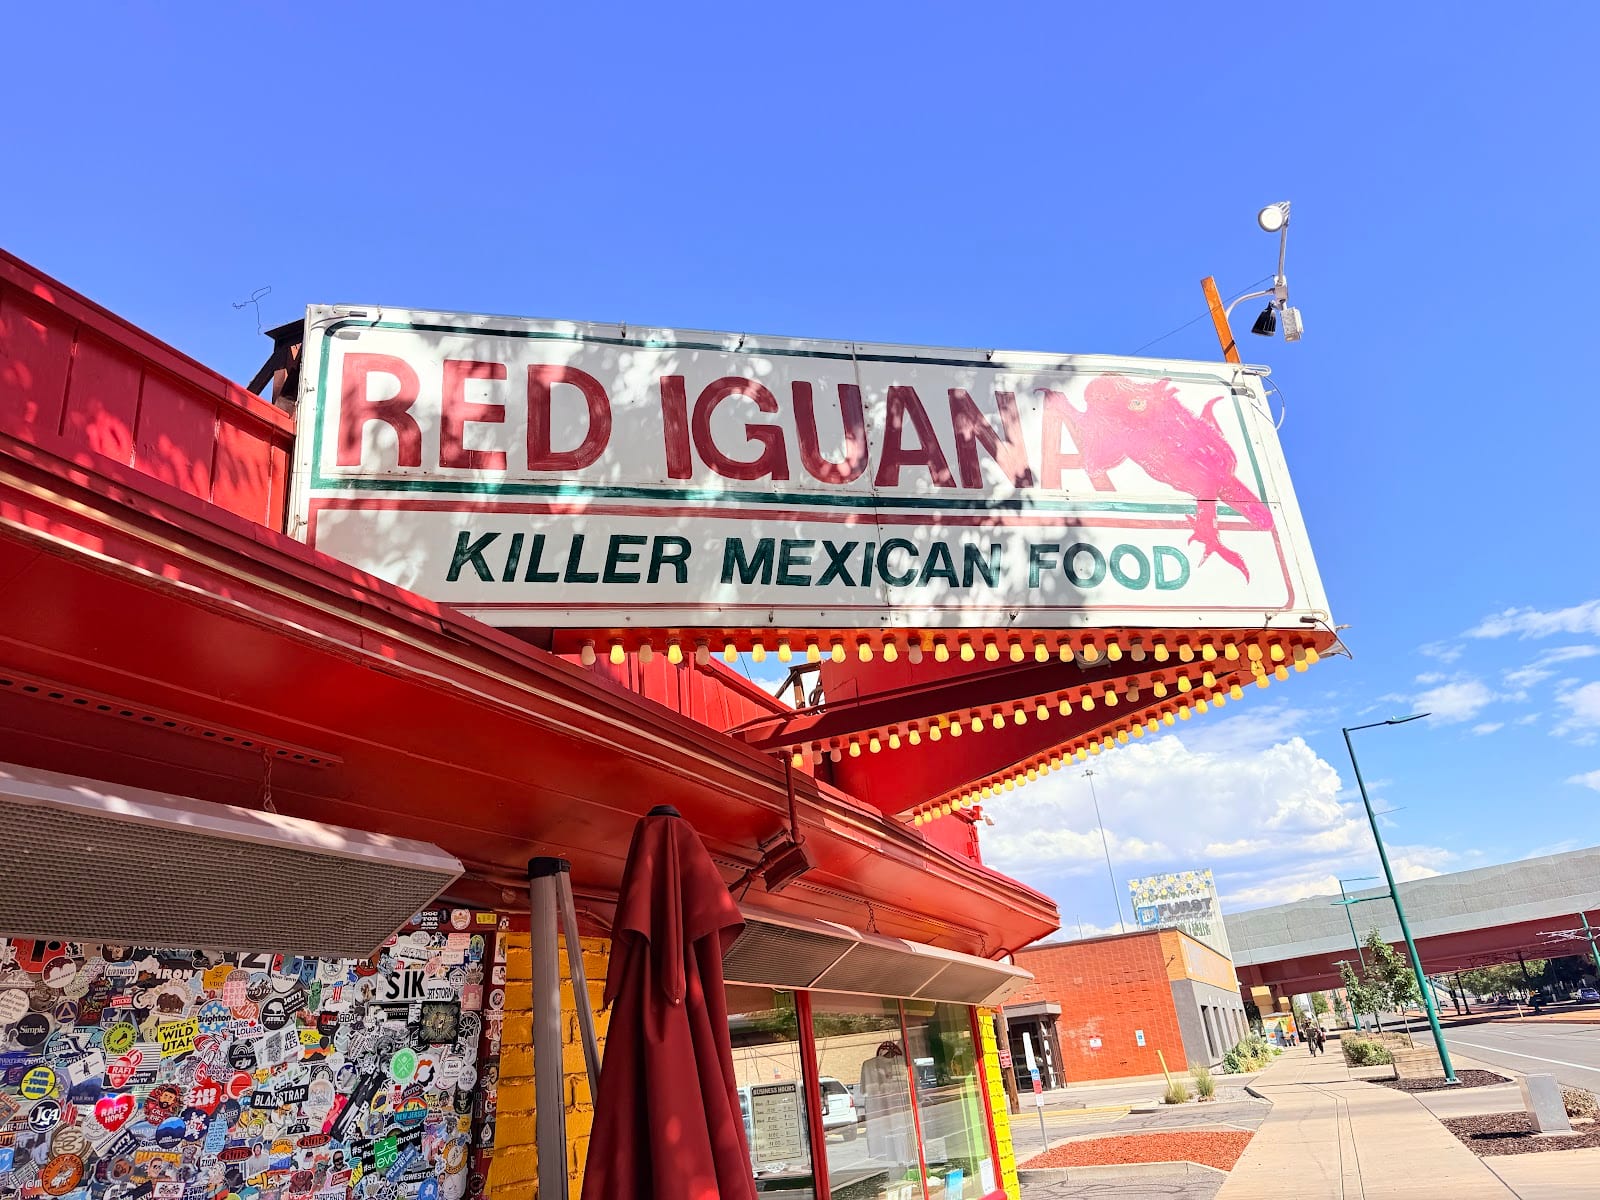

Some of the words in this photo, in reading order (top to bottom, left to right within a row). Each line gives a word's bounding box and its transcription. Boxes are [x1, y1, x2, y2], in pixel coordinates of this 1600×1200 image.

[336, 352, 612, 471] RED
[660, 375, 1117, 492] IGUANA
[446, 531, 692, 583] KILLER
[720, 537, 1001, 588] MEXICAN
[1028, 543, 1191, 590] FOOD
[386, 970, 425, 999] SIK
[160, 1019, 196, 1033] Protect
[197, 1013, 231, 1026] Brighton
[230, 1020, 248, 1029] Lake
[20, 1024, 46, 1036] Simple
[163, 1026, 193, 1041] WILD
[236, 1025, 262, 1036] Louise
[112, 1066, 132, 1074] RAFI
[753, 1088, 777, 1096] BUSINESS
[778, 1085, 796, 1094] HOURS
[101, 1103, 128, 1117] RAFI'S
[396, 1110, 408, 1120] NEW
[408, 1108, 427, 1119] JERSEY
[104, 1112, 125, 1123] HOPE
[376, 1153, 399, 1169] evo
